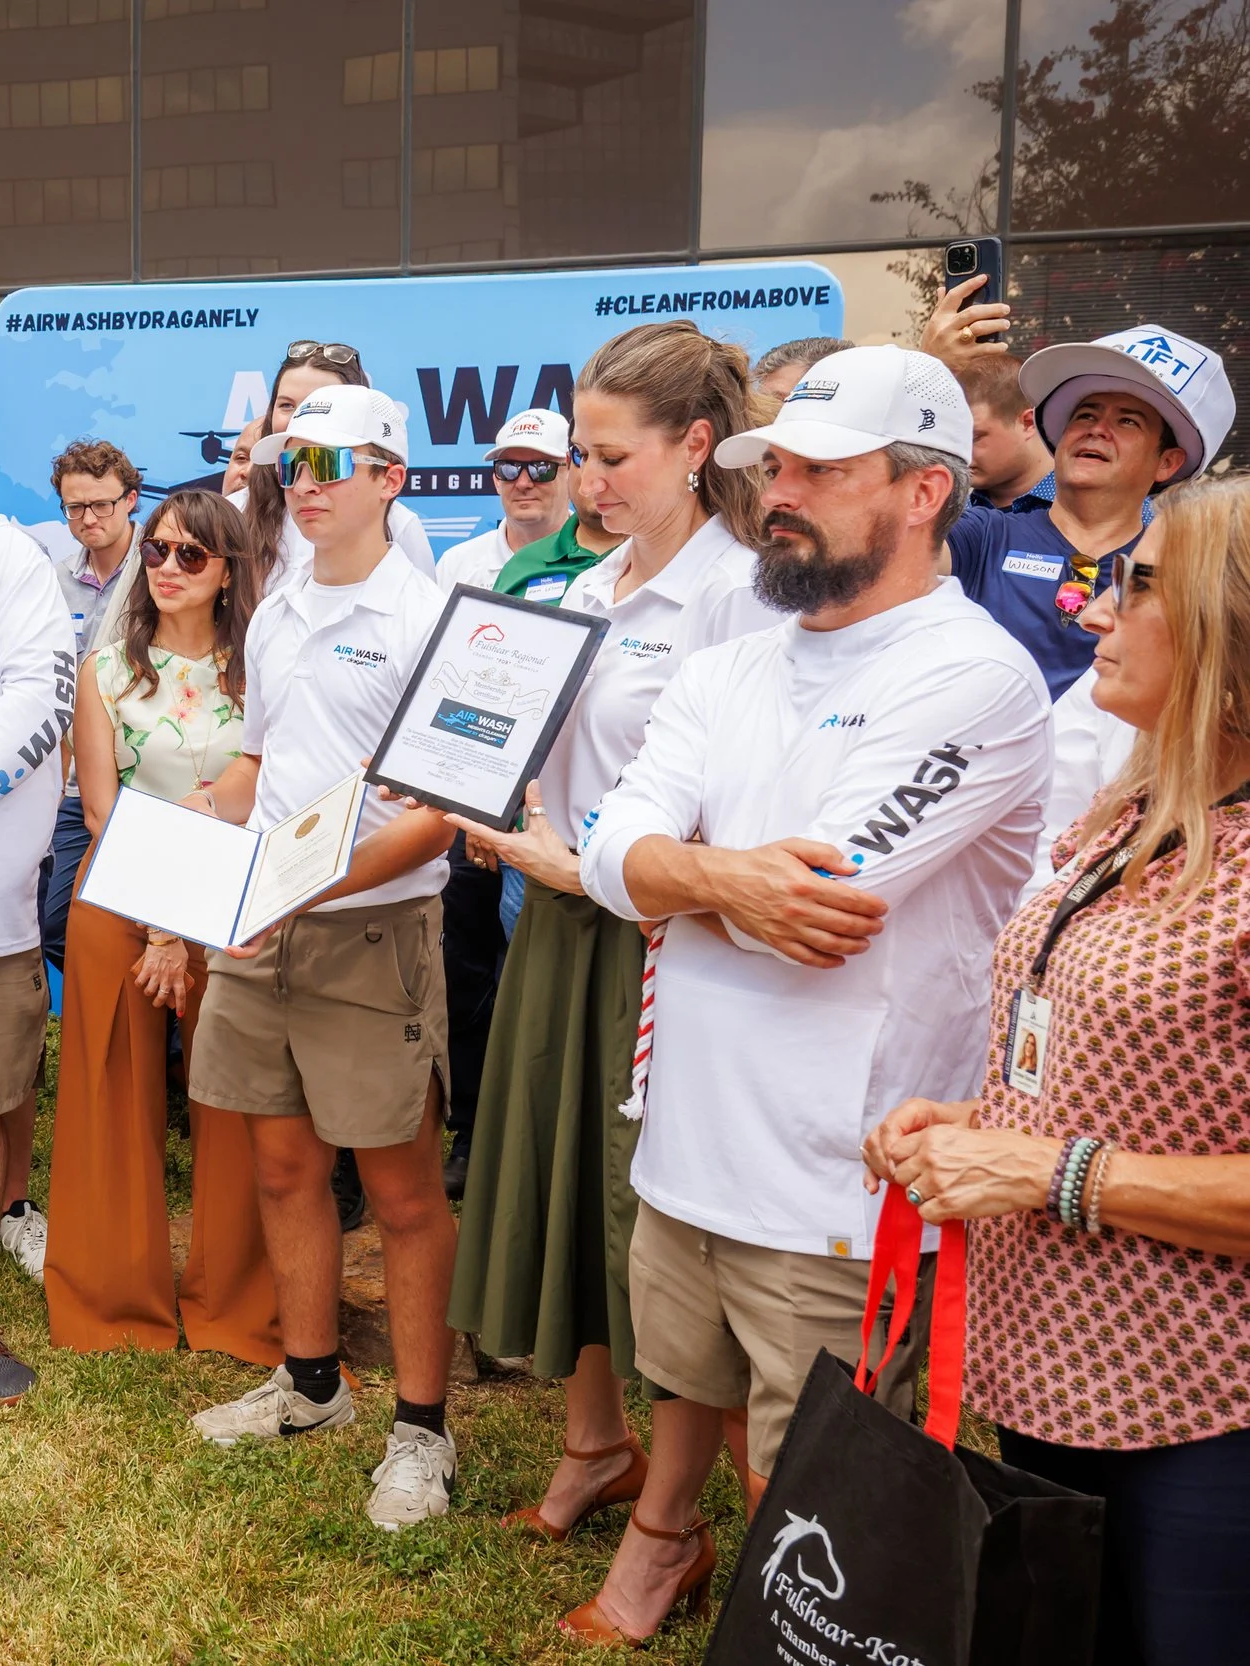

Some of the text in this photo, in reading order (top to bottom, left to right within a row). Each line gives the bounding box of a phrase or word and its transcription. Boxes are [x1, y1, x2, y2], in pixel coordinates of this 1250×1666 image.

[595, 285, 831, 316] #CLEANFROMABOVE
[5, 308, 260, 333] #AIRWASHBYDRAGANFLY
[513, 423, 540, 433] FIRE
[410, 473, 483, 490] EIGH
[1008, 560, 1056, 574] WILSON
[511, 649, 550, 666] Regional
[770, 1609, 837, 1666] A Chamber
